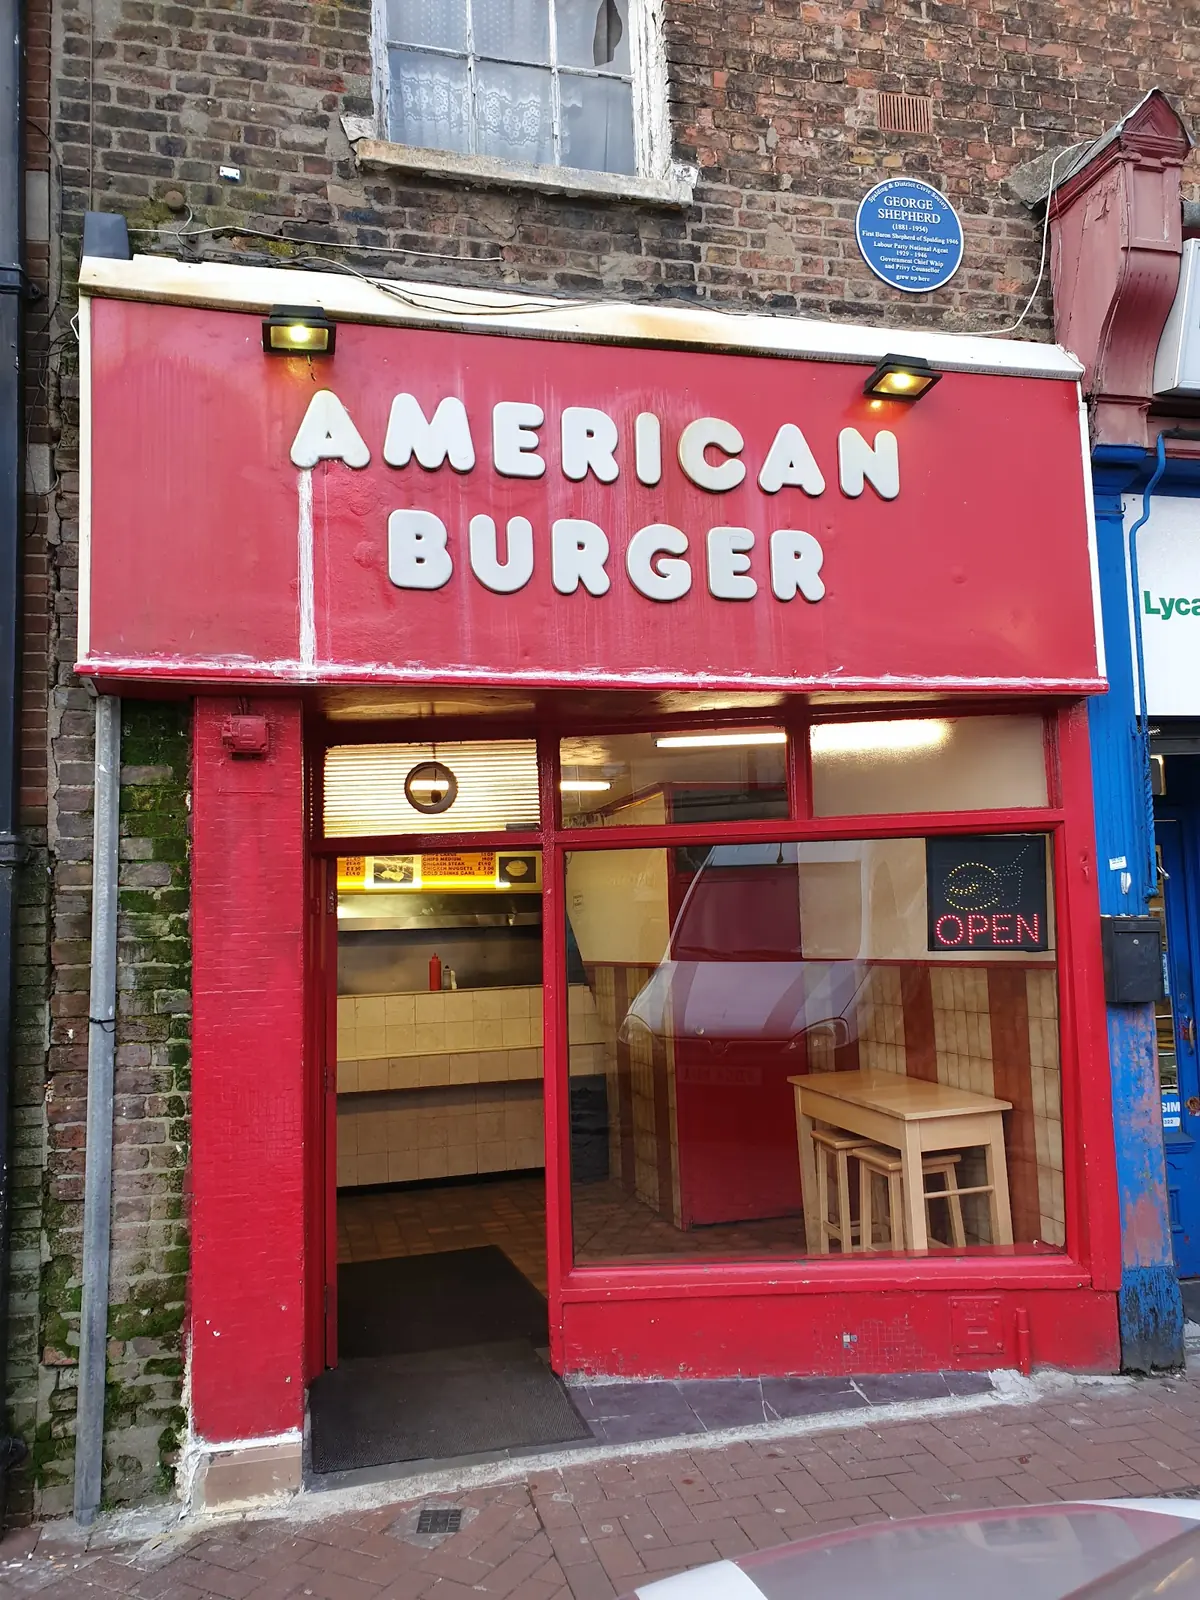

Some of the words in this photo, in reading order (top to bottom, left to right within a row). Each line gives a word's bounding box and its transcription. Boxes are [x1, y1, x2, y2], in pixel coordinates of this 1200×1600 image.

[868, 186, 888, 204] Spalding
[916, 184, 931, 194] Civic
[931, 192, 948, 210] Society
[884, 196, 933, 210] GEORGE
[878, 208, 941, 224] SHEPHERD
[923, 236, 945, 244] Spalding
[290, 389, 900, 502] AMERICAN
[387, 508, 826, 602] BURGER
[935, 912, 1040, 945] OPEN
